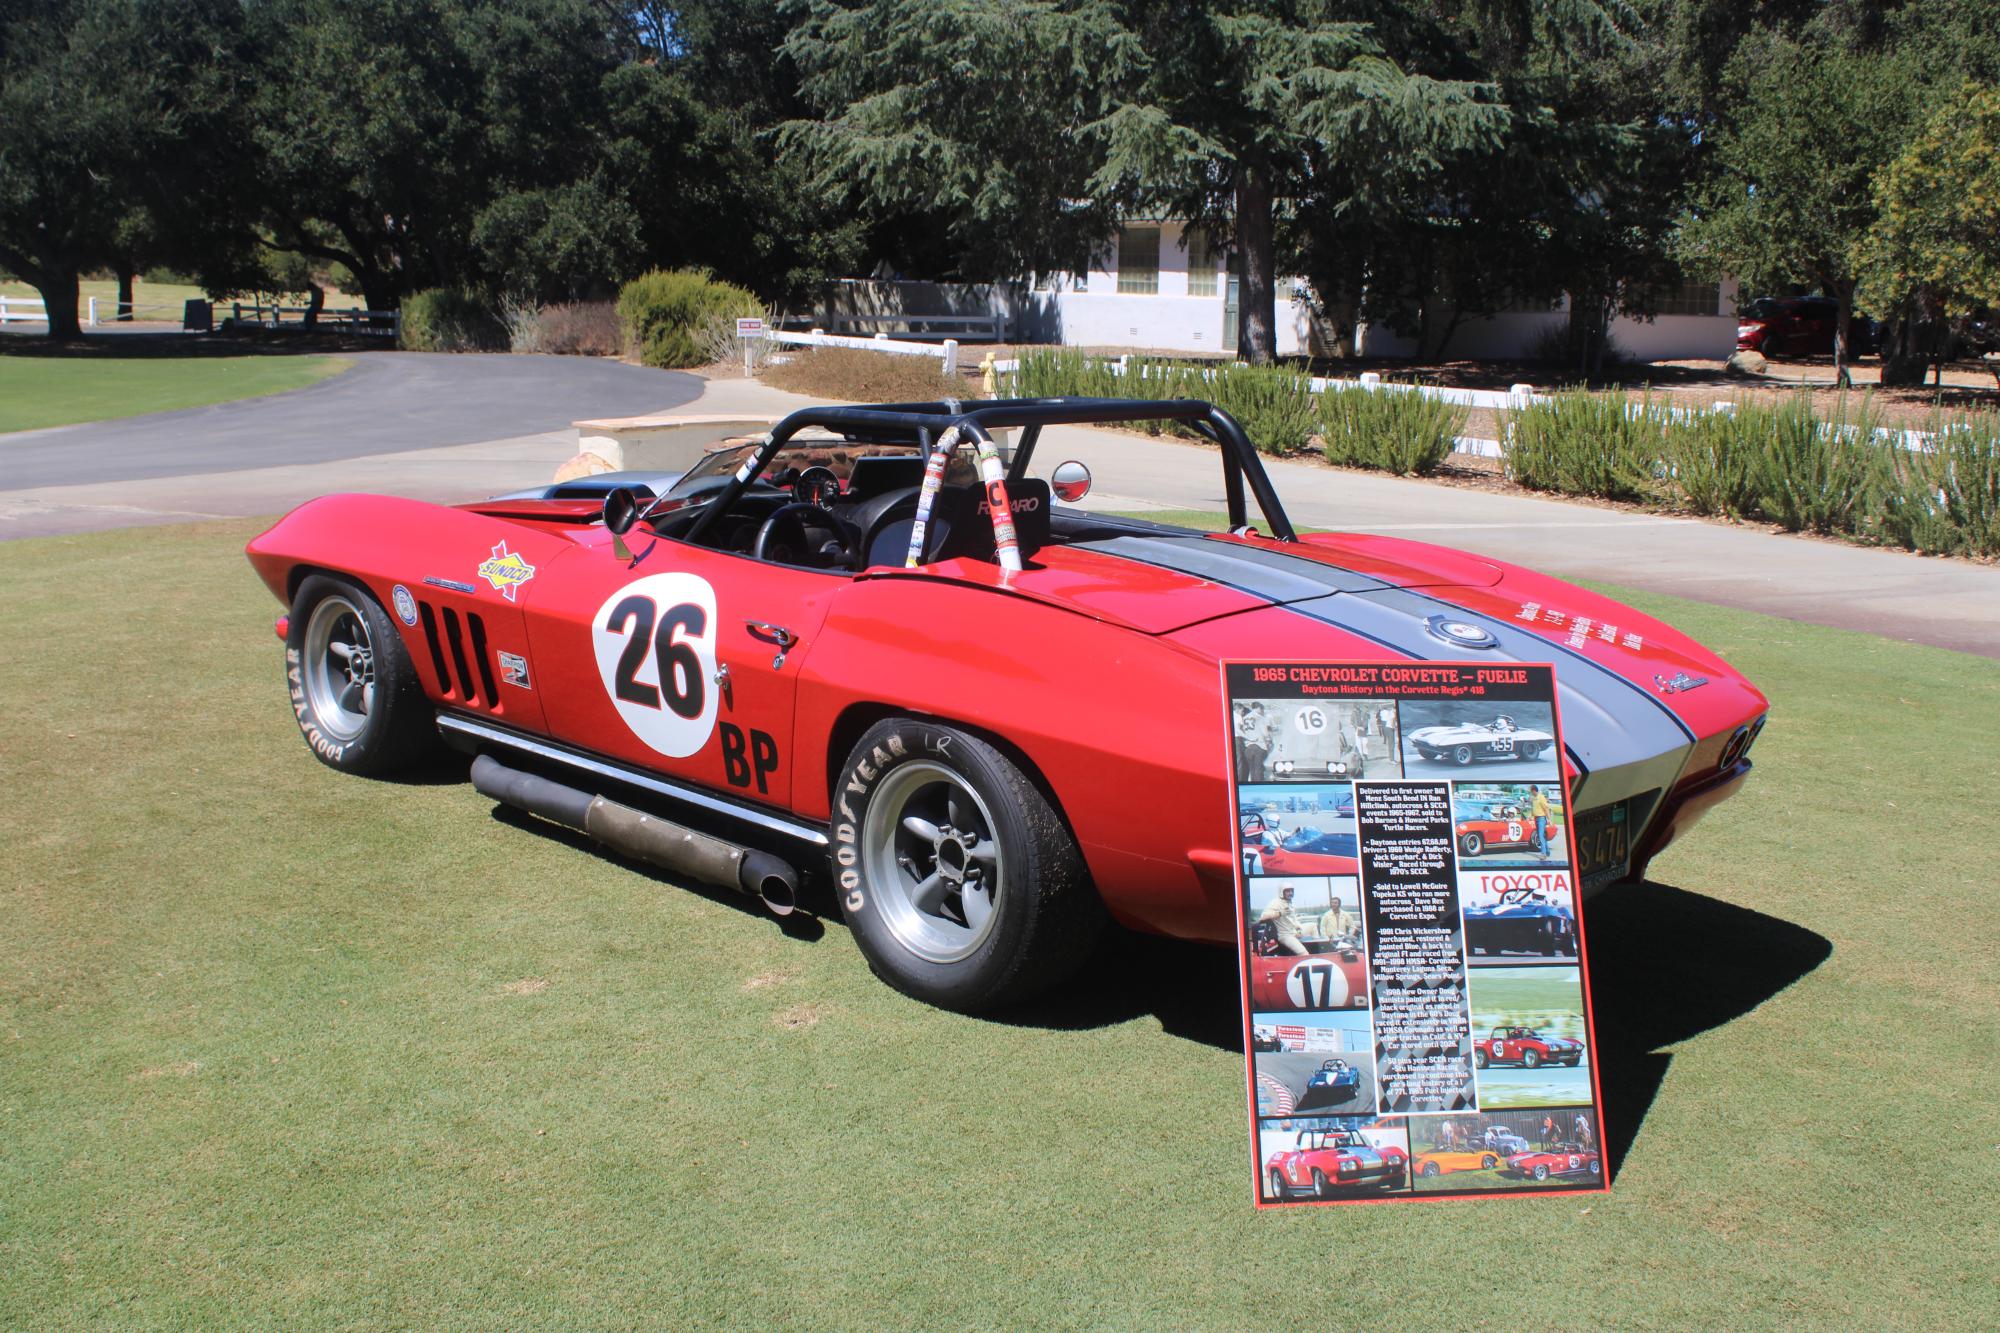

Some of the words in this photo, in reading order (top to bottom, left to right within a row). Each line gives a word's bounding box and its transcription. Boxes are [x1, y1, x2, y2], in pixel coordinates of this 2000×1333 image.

[977, 497, 1039, 515] RARO
[480, 561, 529, 581] SUNOCO
[606, 594, 707, 720] 26
[1253, 667, 1287, 681] 1965
[1290, 668, 1378, 682] CHEVROLET
[1381, 668, 1459, 683] CORVETTE
[1477, 669, 1528, 684] FUELIE
[1302, 684, 1338, 695] Daytona
[1340, 685, 1373, 695] History
[1375, 685, 1385, 694] in
[1386, 685, 1400, 694] the
[1401, 685, 1440, 695] Corvette
[1470, 686, 1485, 695] 418
[1299, 710, 1324, 731] 16
[1498, 737, 1512, 751] 55
[719, 721, 778, 794] BP
[1370, 839, 1397, 847] Daytona
[1419, 861, 1445, 869] through
[1481, 874, 1569, 894] TOYOTA
[1378, 943, 1403, 951] painted
[1374, 951, 1400, 959] original
[1380, 966, 1410, 974] Monterey
[1294, 964, 1334, 1009] 17
[1405, 996, 1430, 1004] painted
[1381, 1012, 1408, 1020] Daytona
[1412, 1057, 1428, 1065] year
[1382, 1074, 1417, 1082] purchased
